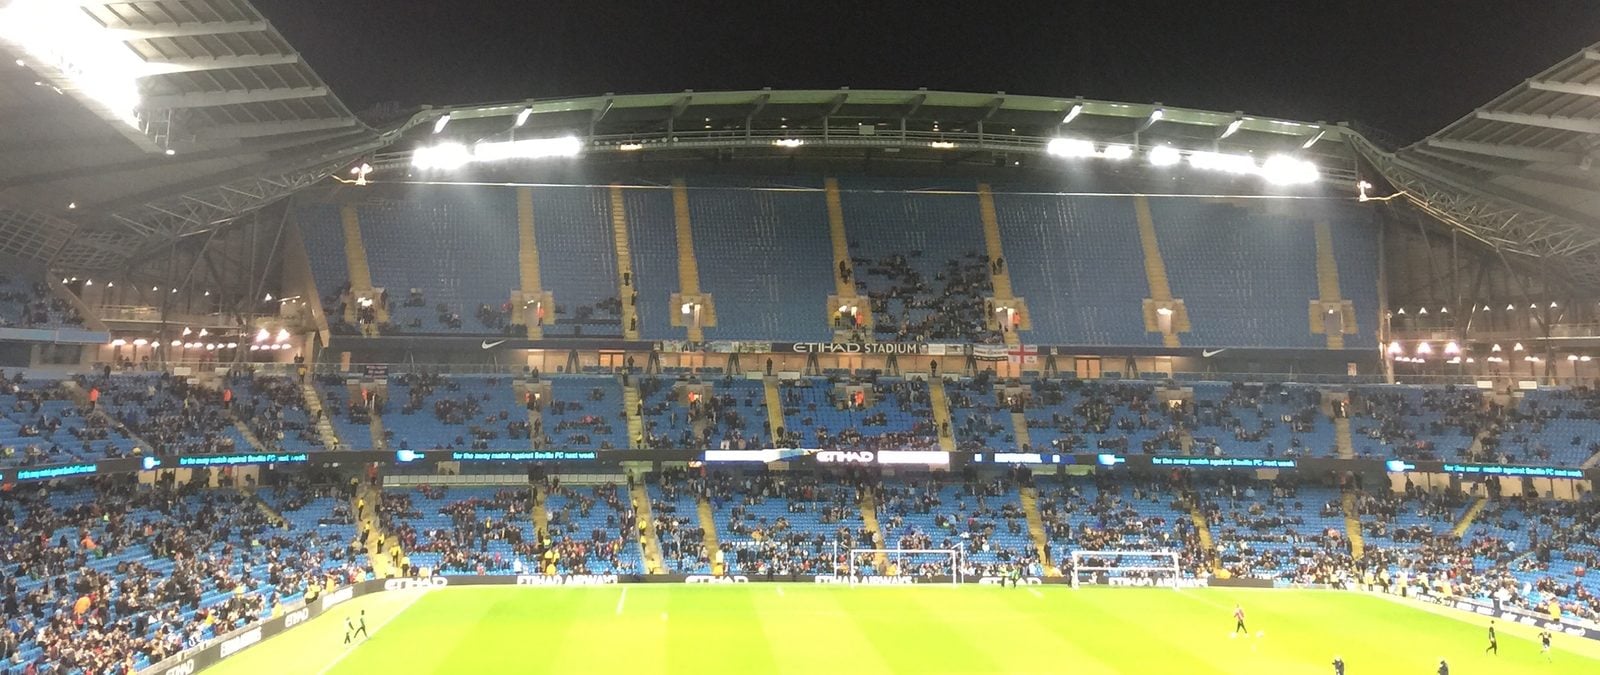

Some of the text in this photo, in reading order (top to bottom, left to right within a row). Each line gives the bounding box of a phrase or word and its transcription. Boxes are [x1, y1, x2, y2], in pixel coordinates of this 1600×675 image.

[793, 342, 917, 353] ETIHAD STADIUM
[266, 454, 276, 462] FC
[816, 450, 874, 462] ETIHAD
[384, 576, 448, 592] ETIHAD
[517, 575, 617, 585] ETIHAD AIRWAYS
[685, 576, 748, 584] ETIHAD
[814, 576, 912, 585] ETIHAD AIRWAYS
[1108, 578, 1154, 586] ETIHAD
